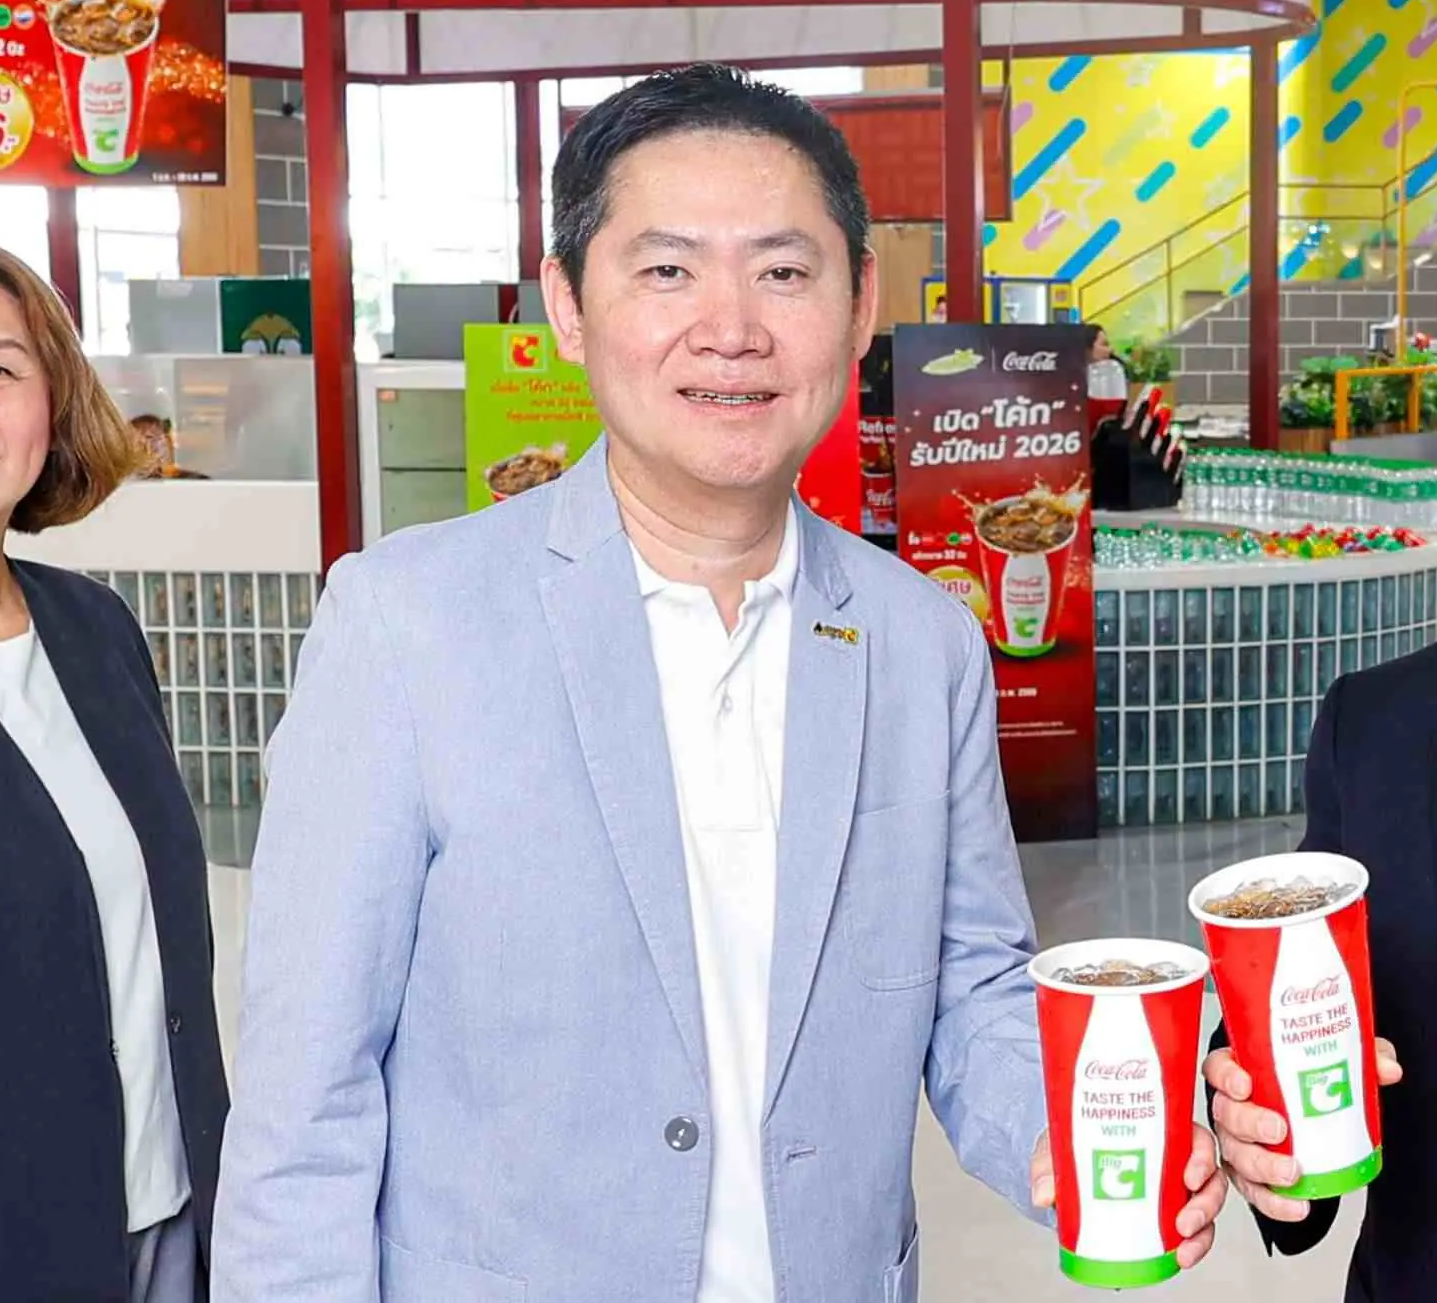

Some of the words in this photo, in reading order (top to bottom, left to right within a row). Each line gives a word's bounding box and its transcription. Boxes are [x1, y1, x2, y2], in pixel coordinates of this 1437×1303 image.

[910, 437, 1006, 467] รับปีใหม่
[1014, 432, 1080, 458] 2026
[1280, 977, 1340, 1007] Coca-Cola
[1281, 1013, 1323, 1030] TASTE
[1327, 1004, 1348, 1018] THE
[1281, 1019, 1351, 1044] HAPPINESS
[1303, 1040, 1338, 1058] WITH
[1084, 1060, 1148, 1080] Coca-Cola
[1083, 1091, 1125, 1105] TASTE
[1130, 1091, 1155, 1103] THE
[1081, 1106, 1155, 1120] HAPPINESS
[1101, 1125, 1137, 1137] WITH
